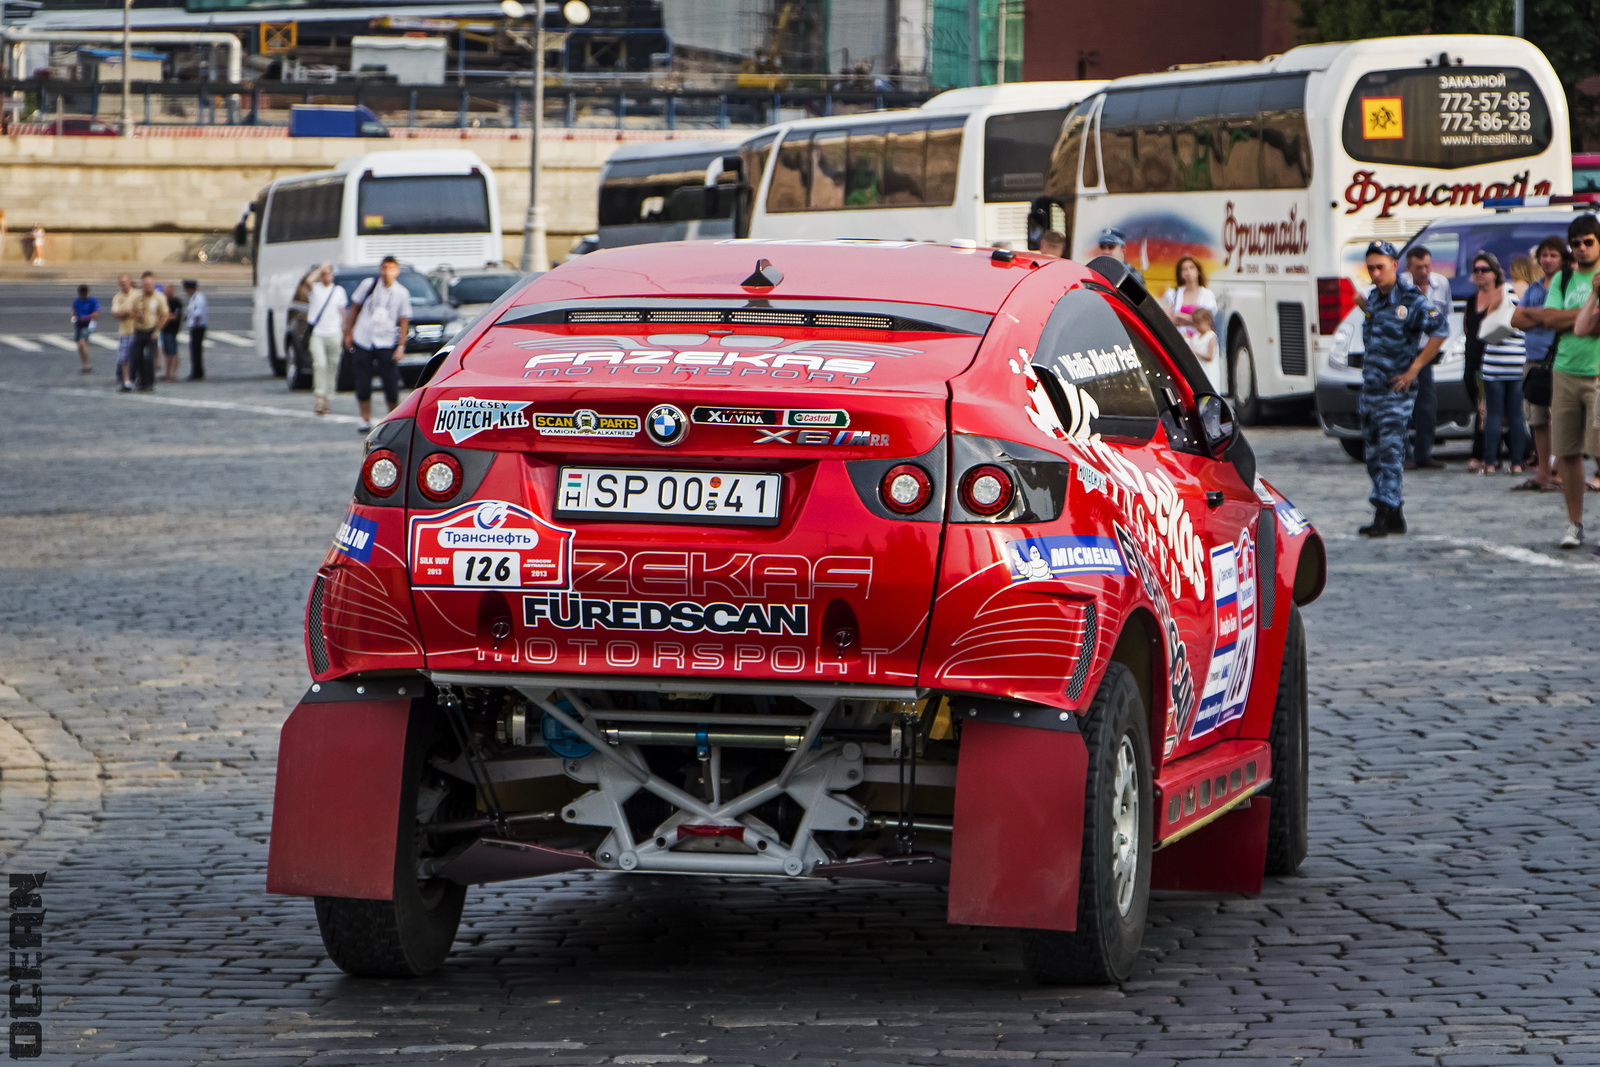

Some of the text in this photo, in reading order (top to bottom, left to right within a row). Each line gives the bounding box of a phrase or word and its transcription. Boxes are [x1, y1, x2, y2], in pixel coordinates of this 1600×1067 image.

[1438, 73, 1506, 89] ЗАКАЗНОЙ
[1438, 92, 1531, 112] 772-57-85
[1439, 112, 1532, 132] 772-86-28
[1440, 133, 1533, 146] www.freestile.ru
[1223, 200, 1309, 274] Фристайл
[524, 350, 877, 375] FAZEKAS
[1057, 351, 1096, 380] Wallis
[1087, 348, 1121, 375] Motor
[522, 365, 871, 385] MOTORSPORT
[499, 411, 528, 427] Kft.
[651, 408, 680, 420] BMW
[803, 414, 832, 423] Castrol
[537, 416, 637, 429] SCAN PARTS
[753, 429, 832, 445] X6
[565, 491, 581, 507] H
[445, 531, 531, 545] Транснефть
[419, 557, 449, 565] SILK WAY
[1050, 547, 1122, 567] MICHELIN
[465, 555, 511, 582] 126
[522, 591, 809, 637] FÜREDSCAN
